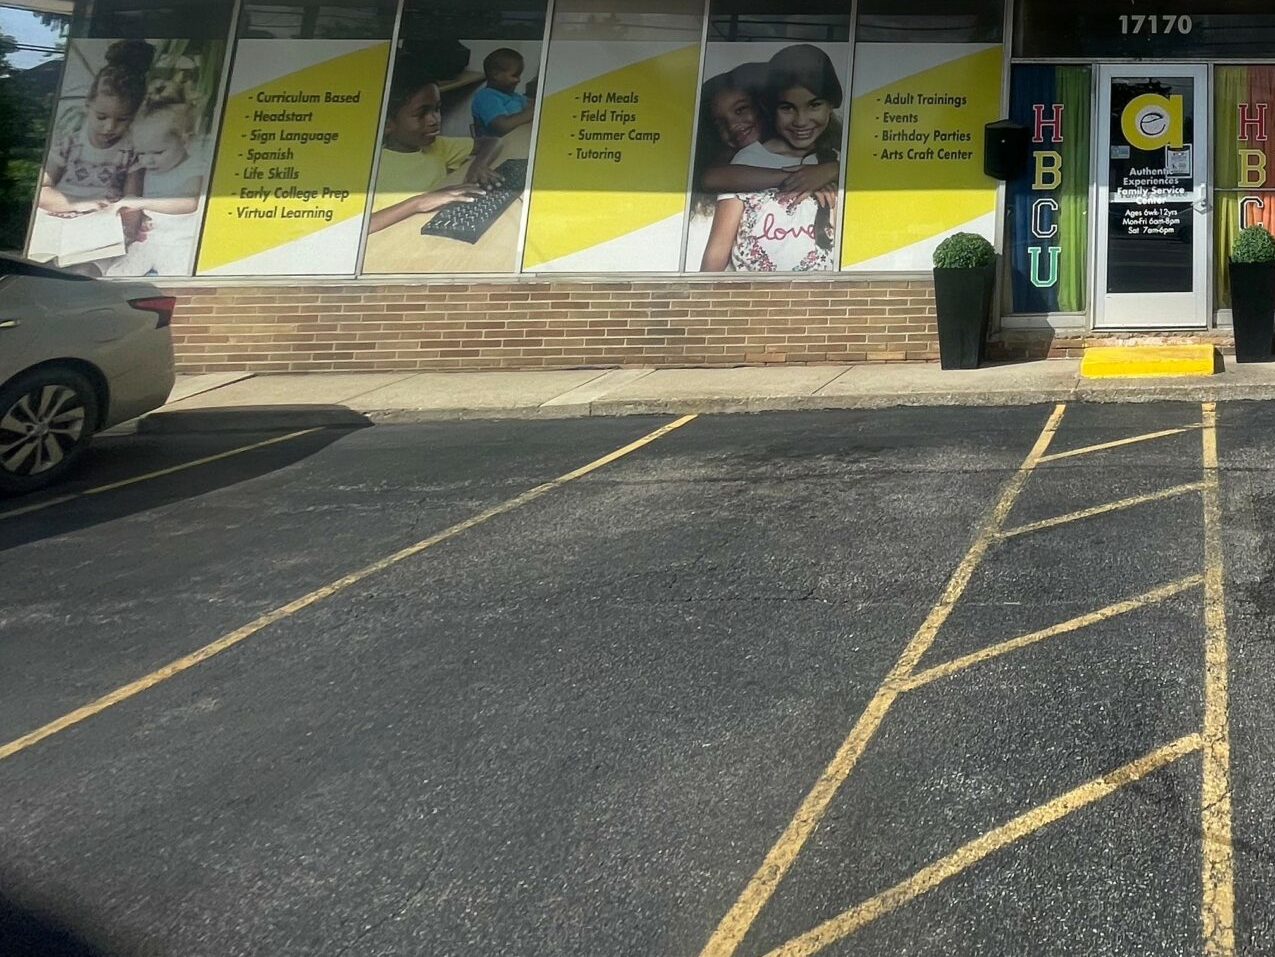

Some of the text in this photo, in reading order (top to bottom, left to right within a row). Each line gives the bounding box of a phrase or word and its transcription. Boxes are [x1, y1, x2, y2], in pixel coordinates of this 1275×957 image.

[1118, 15, 1193, 34] 17170
[257, 91, 361, 103] Curriculum Based
[582, 92, 639, 103] Hot Meals
[884, 93, 967, 108] Adult Trainings
[253, 110, 313, 122] Headstart
[580, 110, 636, 125] Field Trips
[883, 112, 918, 123] Events
[250, 129, 339, 144] Sign Language
[578, 129, 660, 144] Summer Camp
[882, 129, 971, 144] Birthday Parties
[246, 148, 294, 163] Spanish
[576, 147, 621, 163] Tutoring
[881, 148, 973, 160] Arts Craft Center
[243, 167, 299, 179] Life Skills
[1129, 167, 1174, 176] Authentic
[1237, 103, 1268, 231] HBC
[1123, 176, 1179, 187] Experiences
[240, 186, 349, 202] Early College Prep
[1117, 186, 1185, 196] Family Service
[236, 206, 333, 221] Virtual Learning
[1125, 209, 1142, 218] Ages
[756, 213, 816, 240] love
